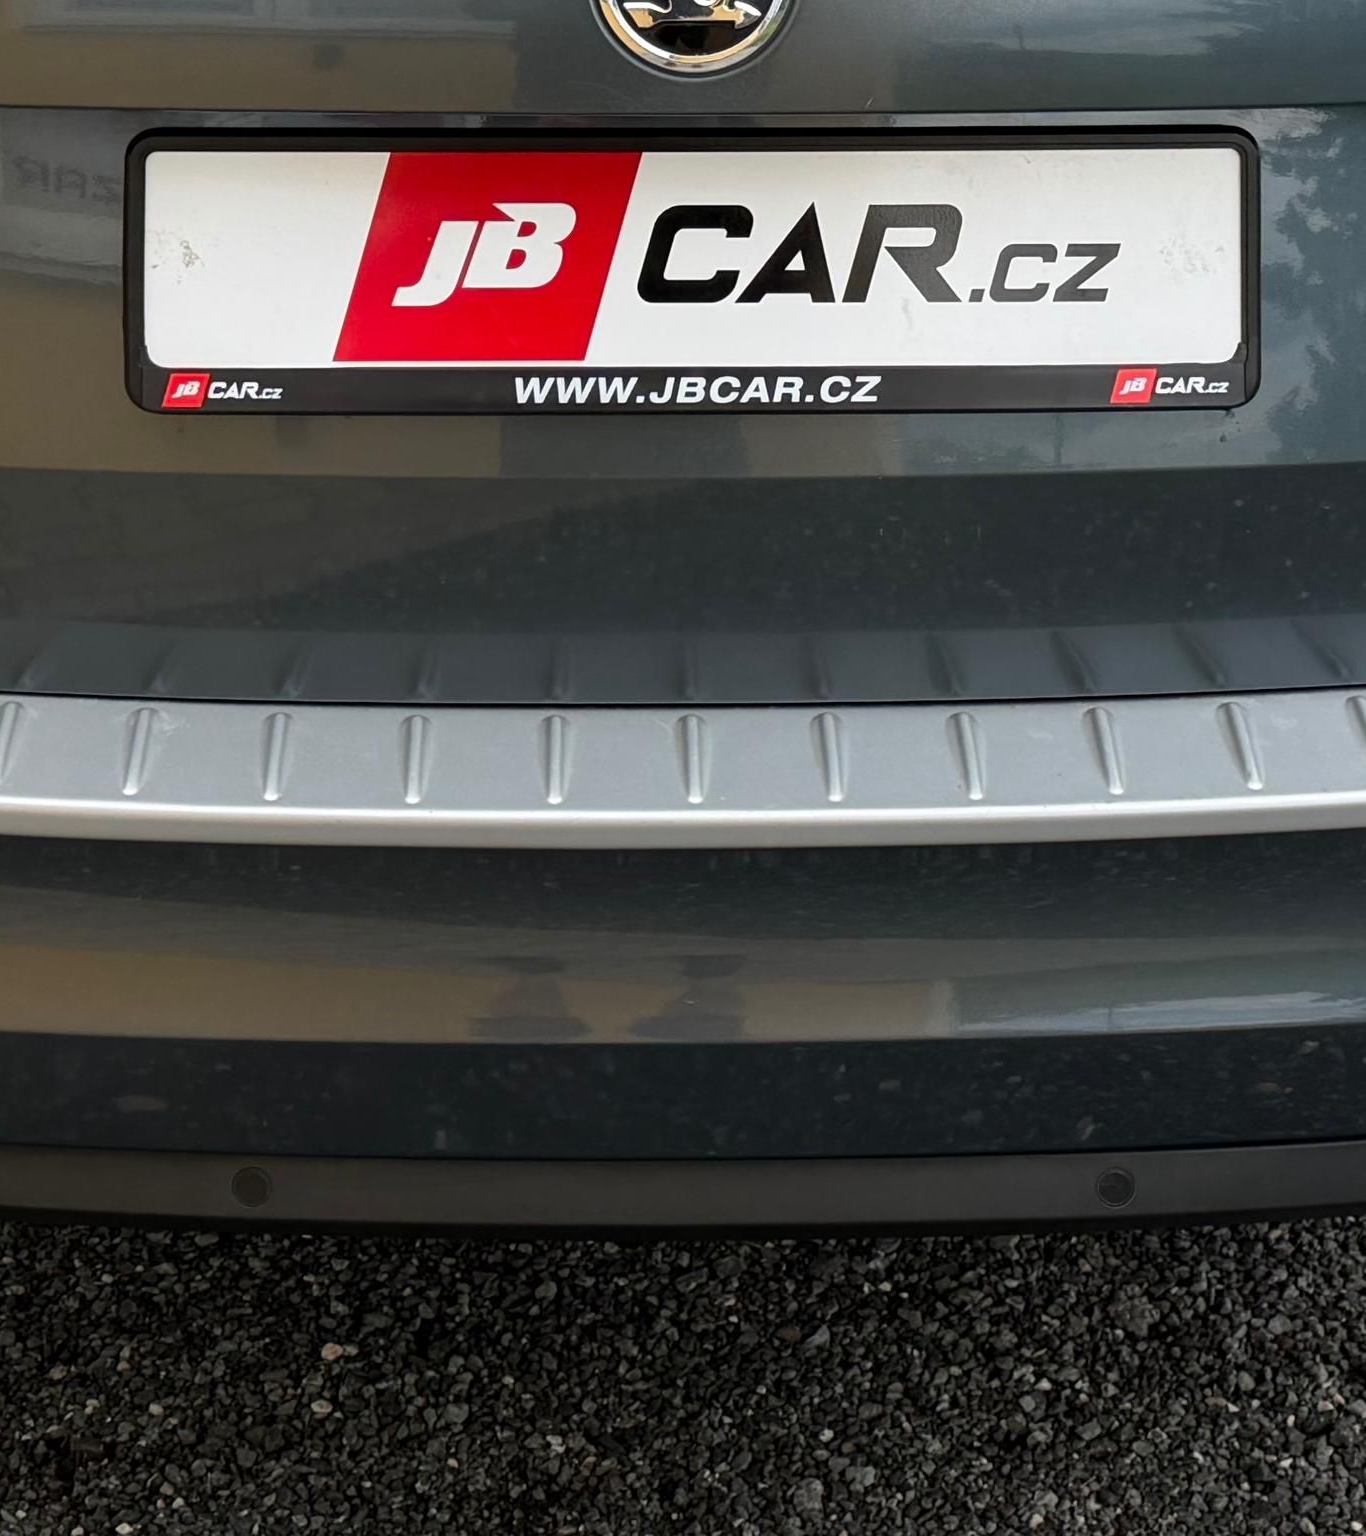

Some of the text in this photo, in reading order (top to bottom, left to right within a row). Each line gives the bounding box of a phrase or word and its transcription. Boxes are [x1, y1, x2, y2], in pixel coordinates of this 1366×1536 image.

[391, 202, 576, 306] JB
[171, 381, 201, 399] JB
[514, 376, 882, 404] WWW.JBCAR.CZ
[1119, 377, 1147, 395] JB
